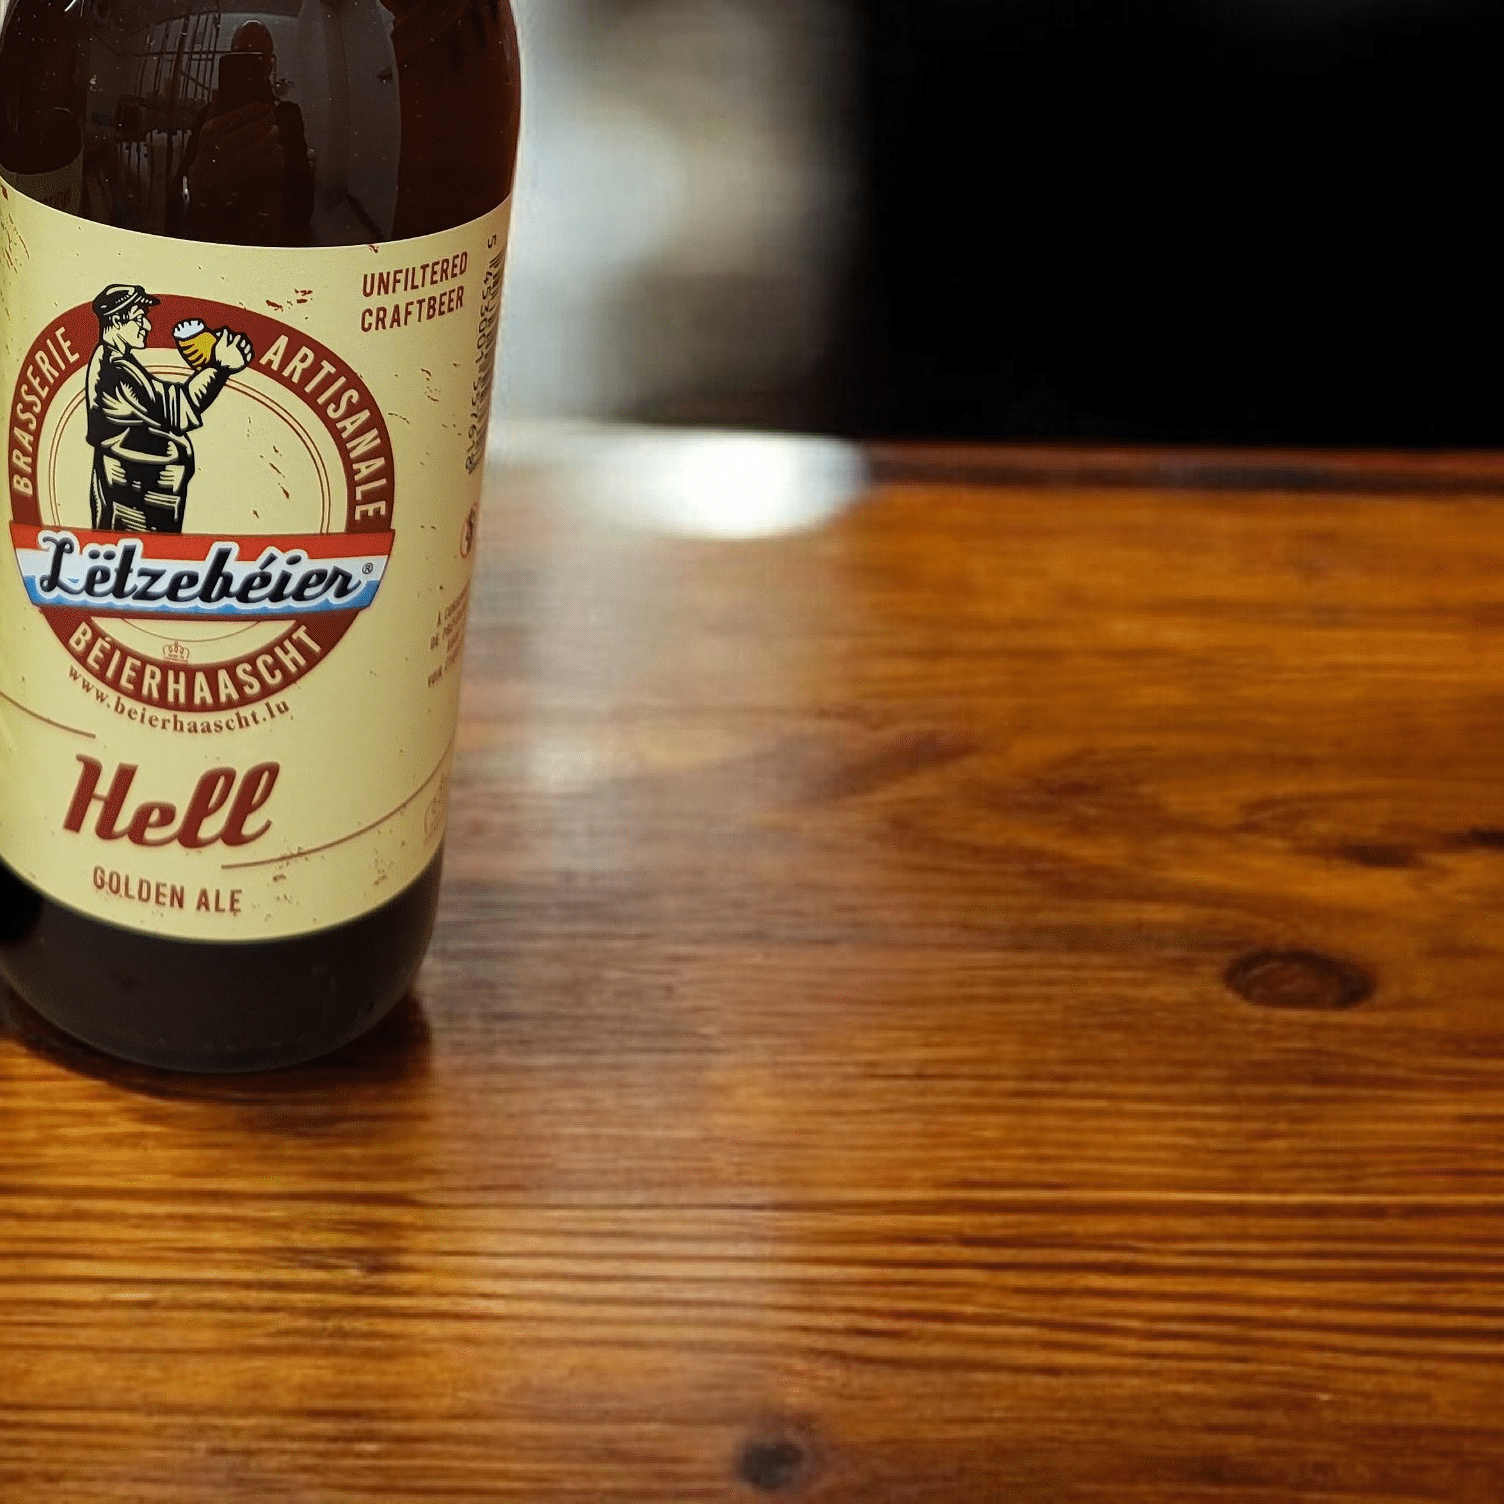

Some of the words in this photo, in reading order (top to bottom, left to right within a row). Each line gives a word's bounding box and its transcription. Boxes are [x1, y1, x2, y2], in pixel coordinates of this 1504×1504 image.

[360, 285, 465, 333] CRAFTBEER
[362, 251, 468, 298] UNFILTERED
[13, 325, 80, 495] BRASSERIE
[260, 335, 386, 523] ARTISANALE
[68, 621, 322, 707] BÉIERHAASCHT
[68, 664, 290, 735] www.beierhaascht.lu
[62, 753, 280, 849] Hell
[93, 864, 185, 909] GOLDEN
[194, 884, 242, 914] ALE
